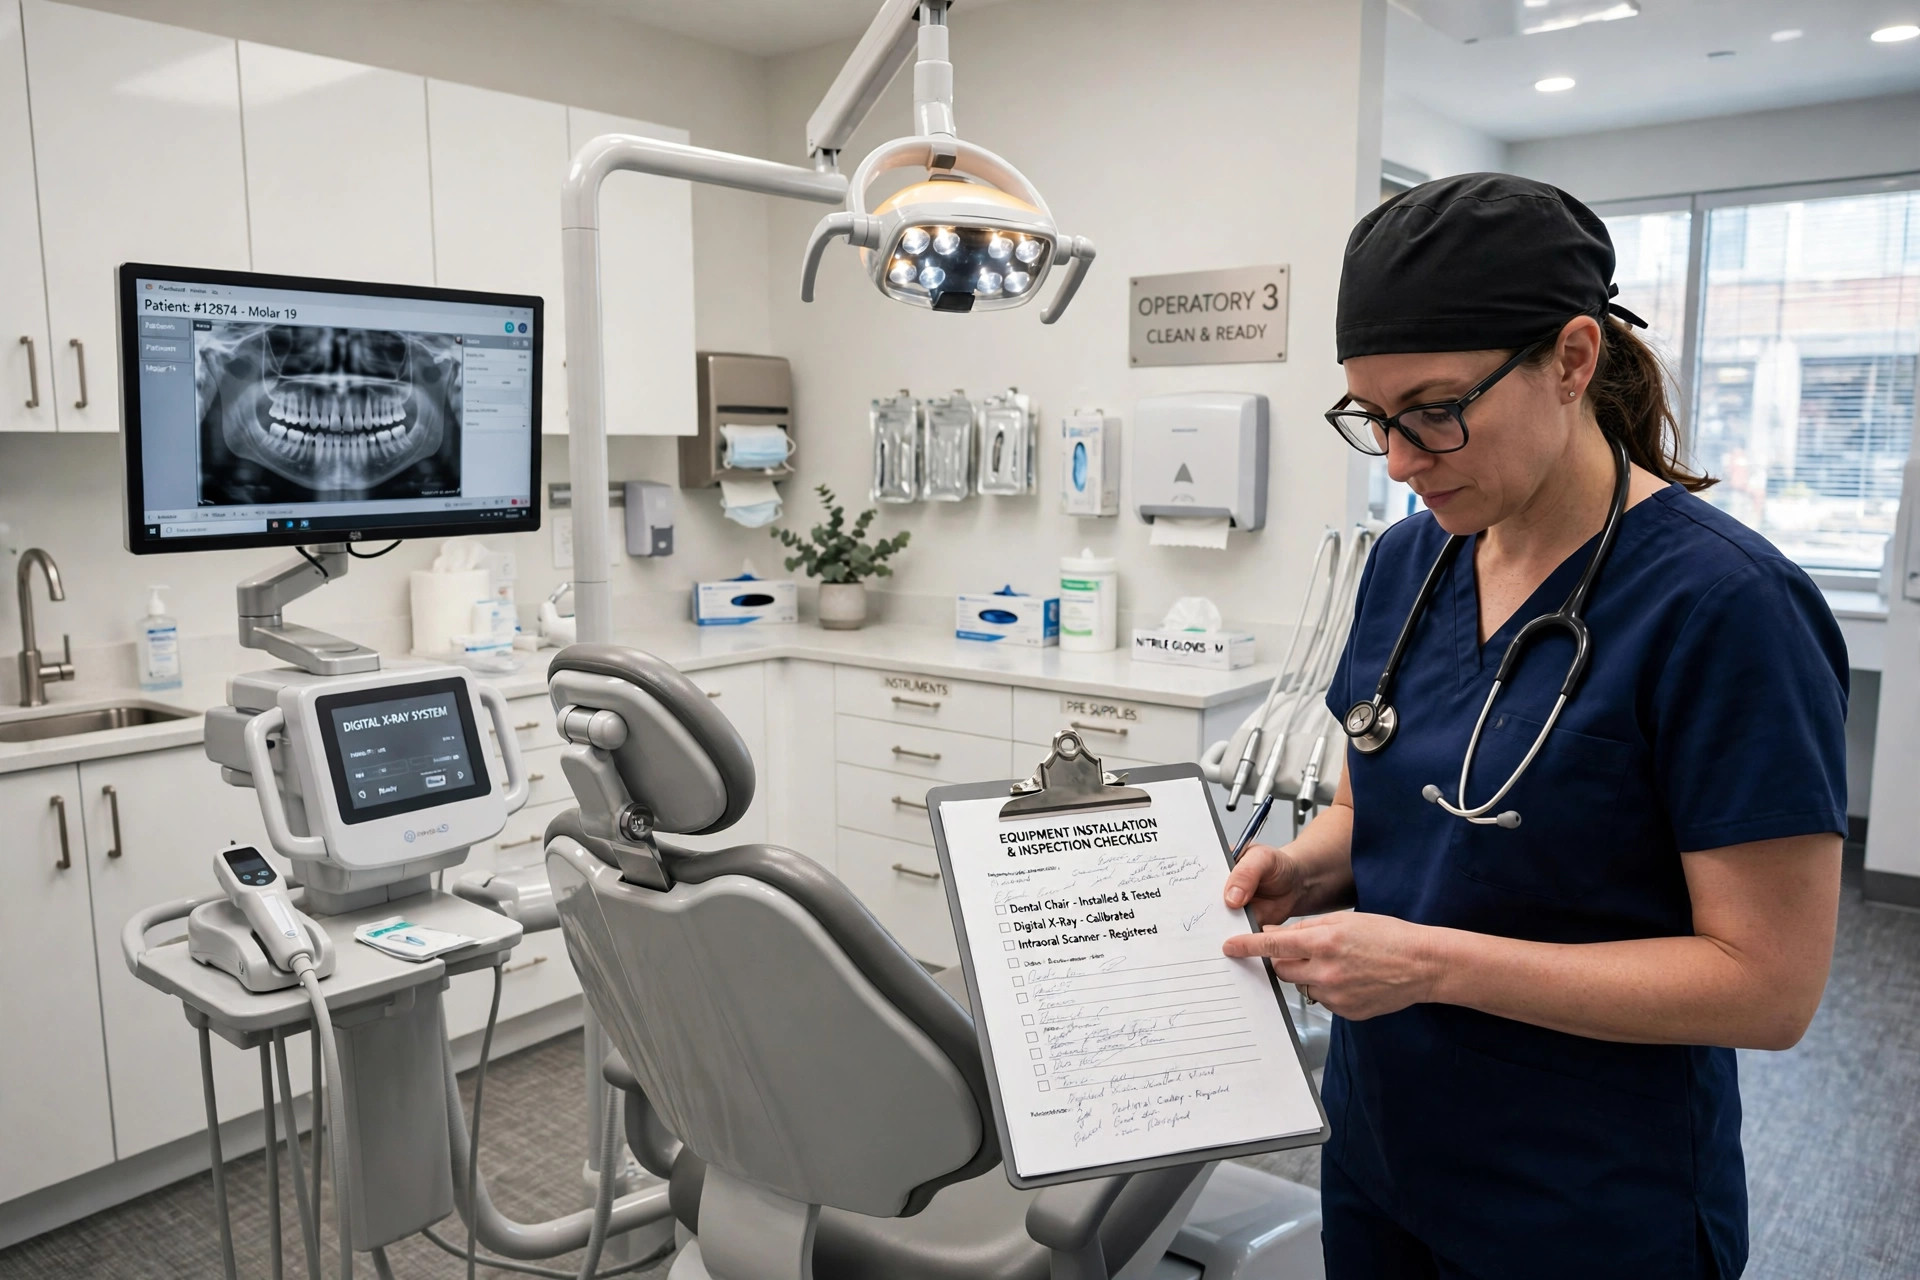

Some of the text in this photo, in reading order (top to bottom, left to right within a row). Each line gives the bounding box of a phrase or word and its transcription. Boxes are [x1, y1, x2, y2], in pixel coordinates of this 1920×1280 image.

[144, 298, 190, 313] Patient:
[193, 302, 237, 316] #12874
[248, 306, 280, 319] Molar
[284, 308, 297, 319] 19
[1138, 283, 1279, 316] OPERATORY 3
[1146, 323, 1268, 344] CLEAN & READY
[1215, 643, 1223, 653] M
[884, 677, 949, 696] INSTRUMENTS
[342, 706, 448, 732] DIGITAL X-RAY SYSTEM
[1066, 700, 1138, 721] PPE SUPPLIES
[999, 817, 1158, 844] EQUIPMENT INSTALLATION
[1007, 831, 1159, 858] & INSPECTION CHECKLIST
[1009, 900, 1042, 914] Dental
[1044, 898, 1071, 911] Chair
[1078, 891, 1119, 906] Installed
[1121, 891, 1130, 902] &
[1130, 887, 1162, 900] Tested
[1013, 918, 1046, 934] Digital
[1048, 916, 1077, 929] X-Ray
[1086, 908, 1135, 923] Calibrated
[1018, 935, 1060, 950] Intraoral
[1062, 932, 1100, 945] Scanner
[1109, 924, 1158, 941] Registered
